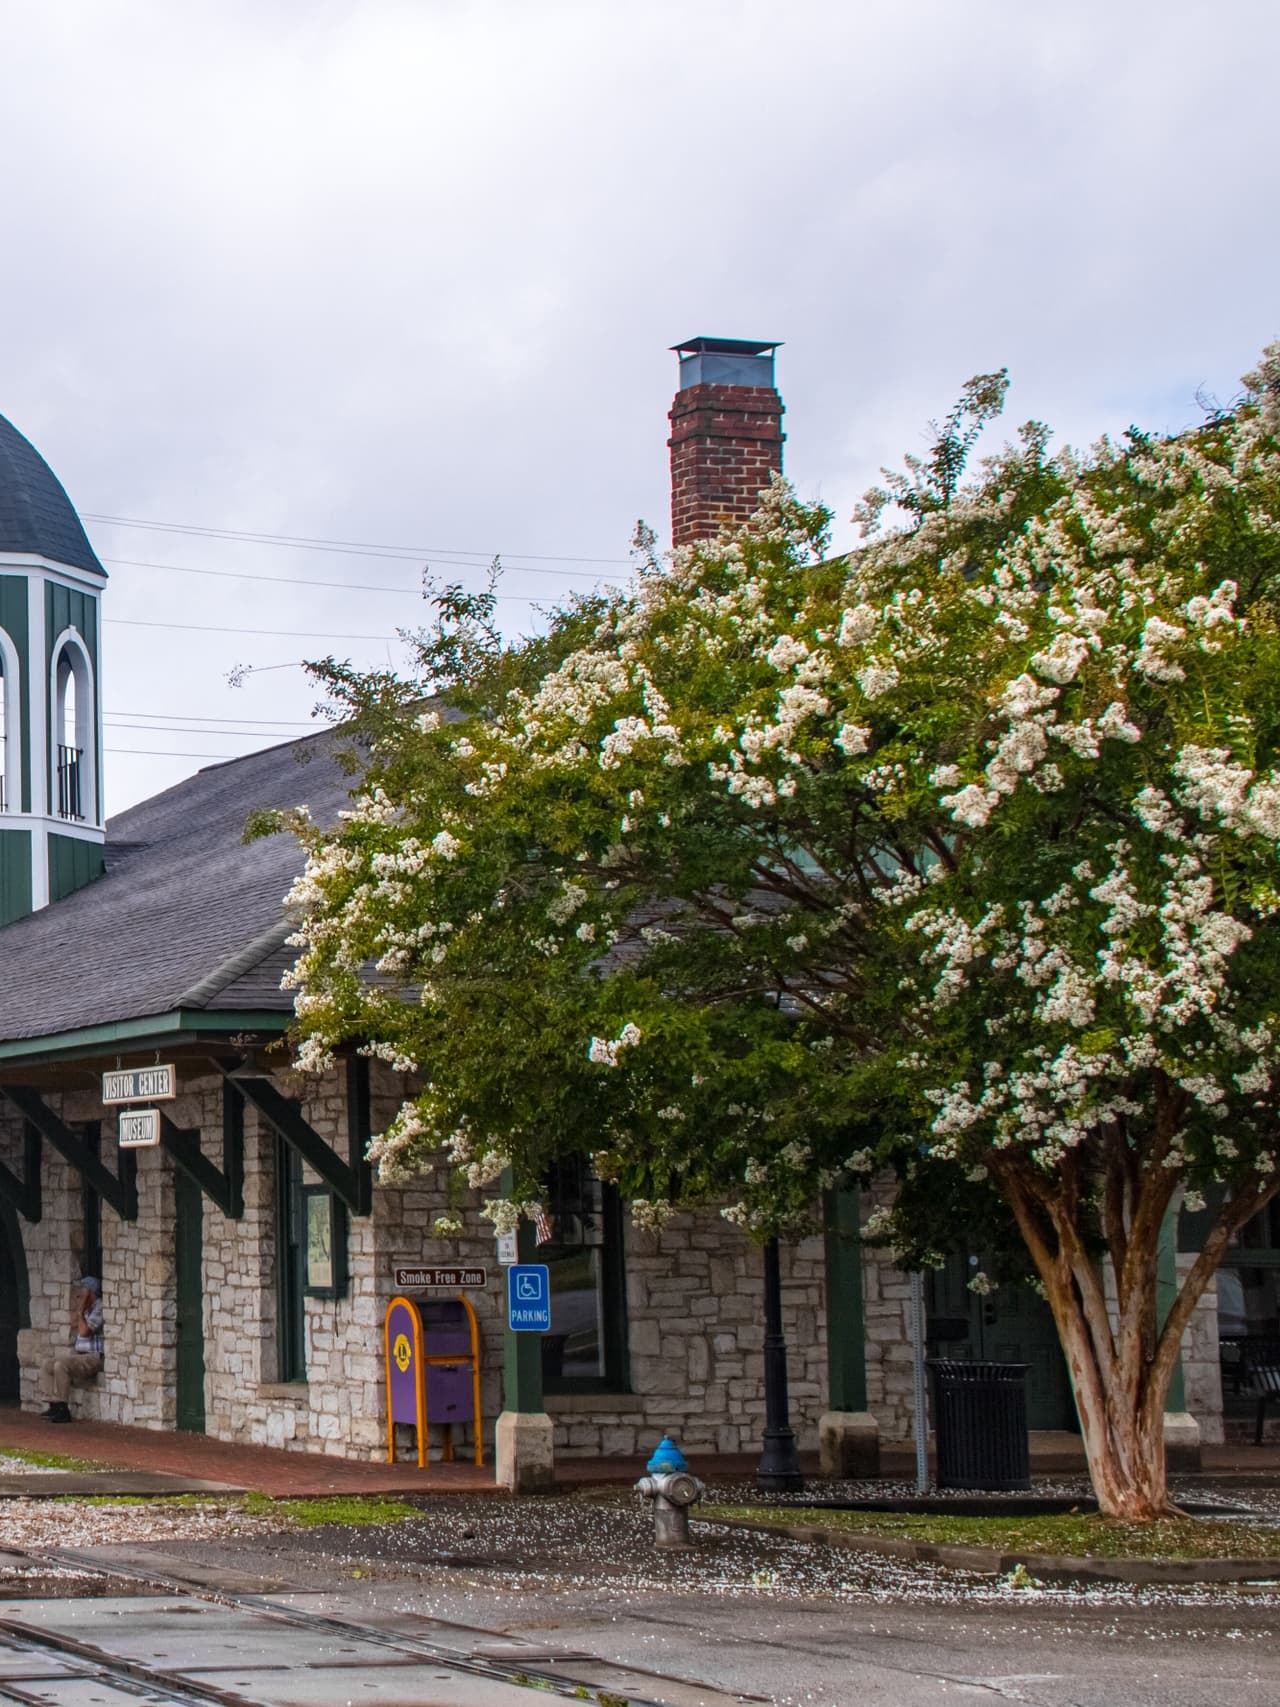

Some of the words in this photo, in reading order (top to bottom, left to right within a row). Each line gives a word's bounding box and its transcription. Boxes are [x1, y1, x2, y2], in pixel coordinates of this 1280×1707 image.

[105, 1075, 134, 1098] VISITOR
[139, 1071, 169, 1095] CENTER
[122, 1117, 153, 1139] MUSEUM
[400, 1271, 431, 1285] Smoke
[435, 1271, 456, 1285] Free
[460, 1270, 482, 1284] Zone
[511, 1310, 548, 1322] PARKING
